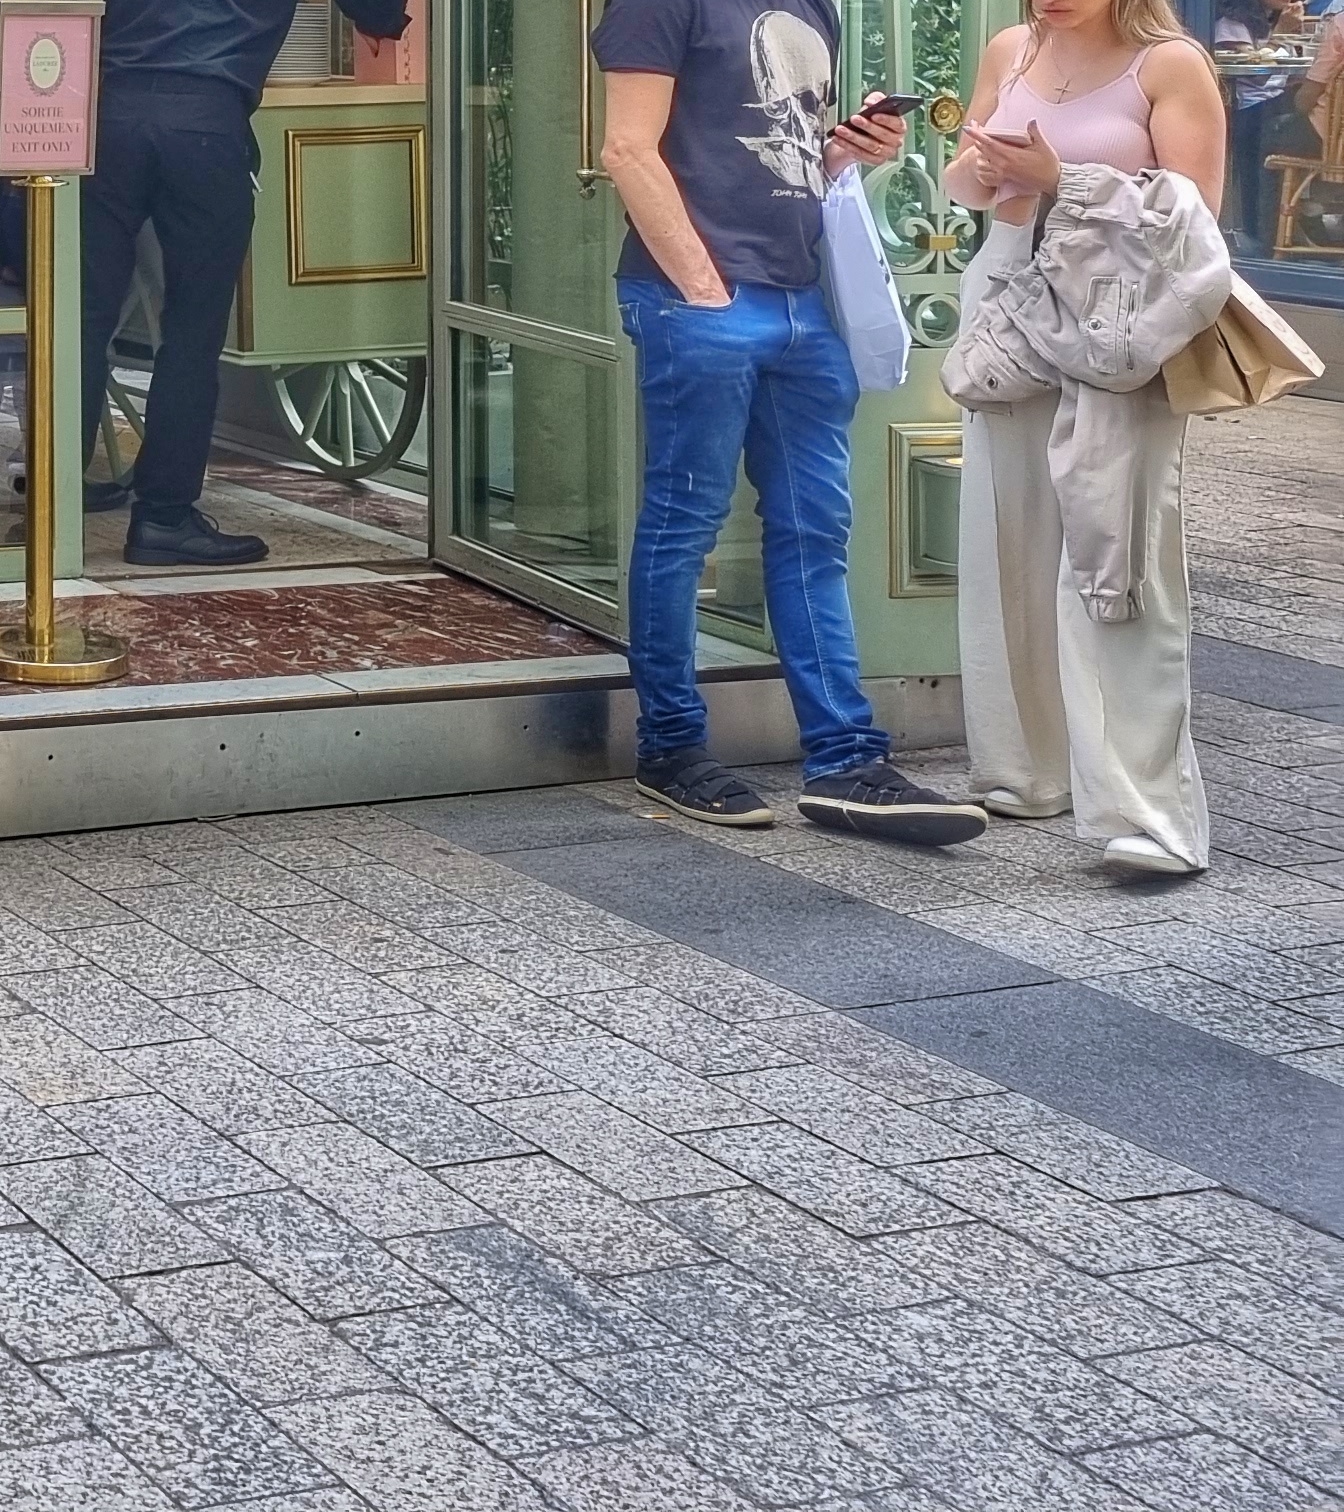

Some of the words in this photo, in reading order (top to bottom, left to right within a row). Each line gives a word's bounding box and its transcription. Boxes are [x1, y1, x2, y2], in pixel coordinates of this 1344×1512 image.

[21, 106, 64, 118] SORTIE
[4, 122, 80, 136] UNIQUEMENT
[12, 141, 39, 153] EXIT
[42, 141, 72, 153] ONLY
